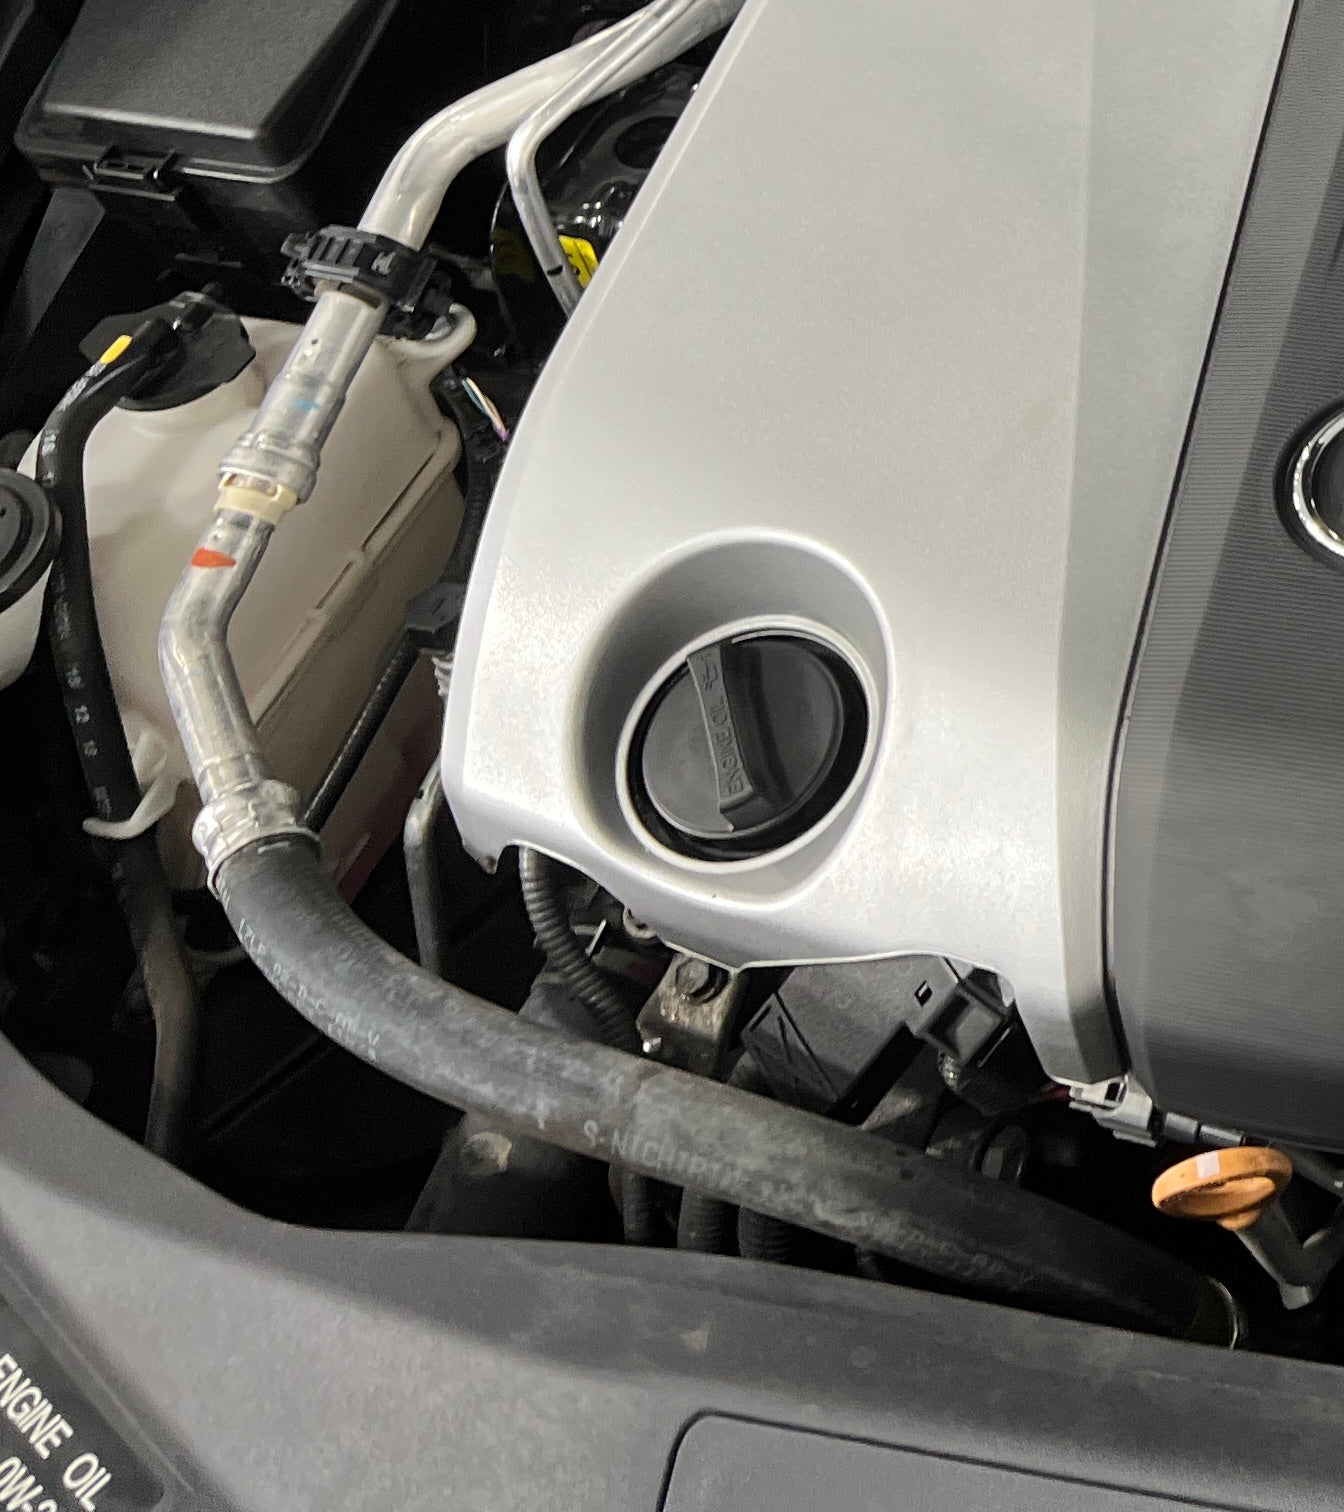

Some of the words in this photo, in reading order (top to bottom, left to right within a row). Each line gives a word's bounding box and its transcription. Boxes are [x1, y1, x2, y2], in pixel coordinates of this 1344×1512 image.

[710, 695, 730, 725] OIL
[714, 730, 745, 796] ENGINE
[62, 1452, 112, 1512] OIL
